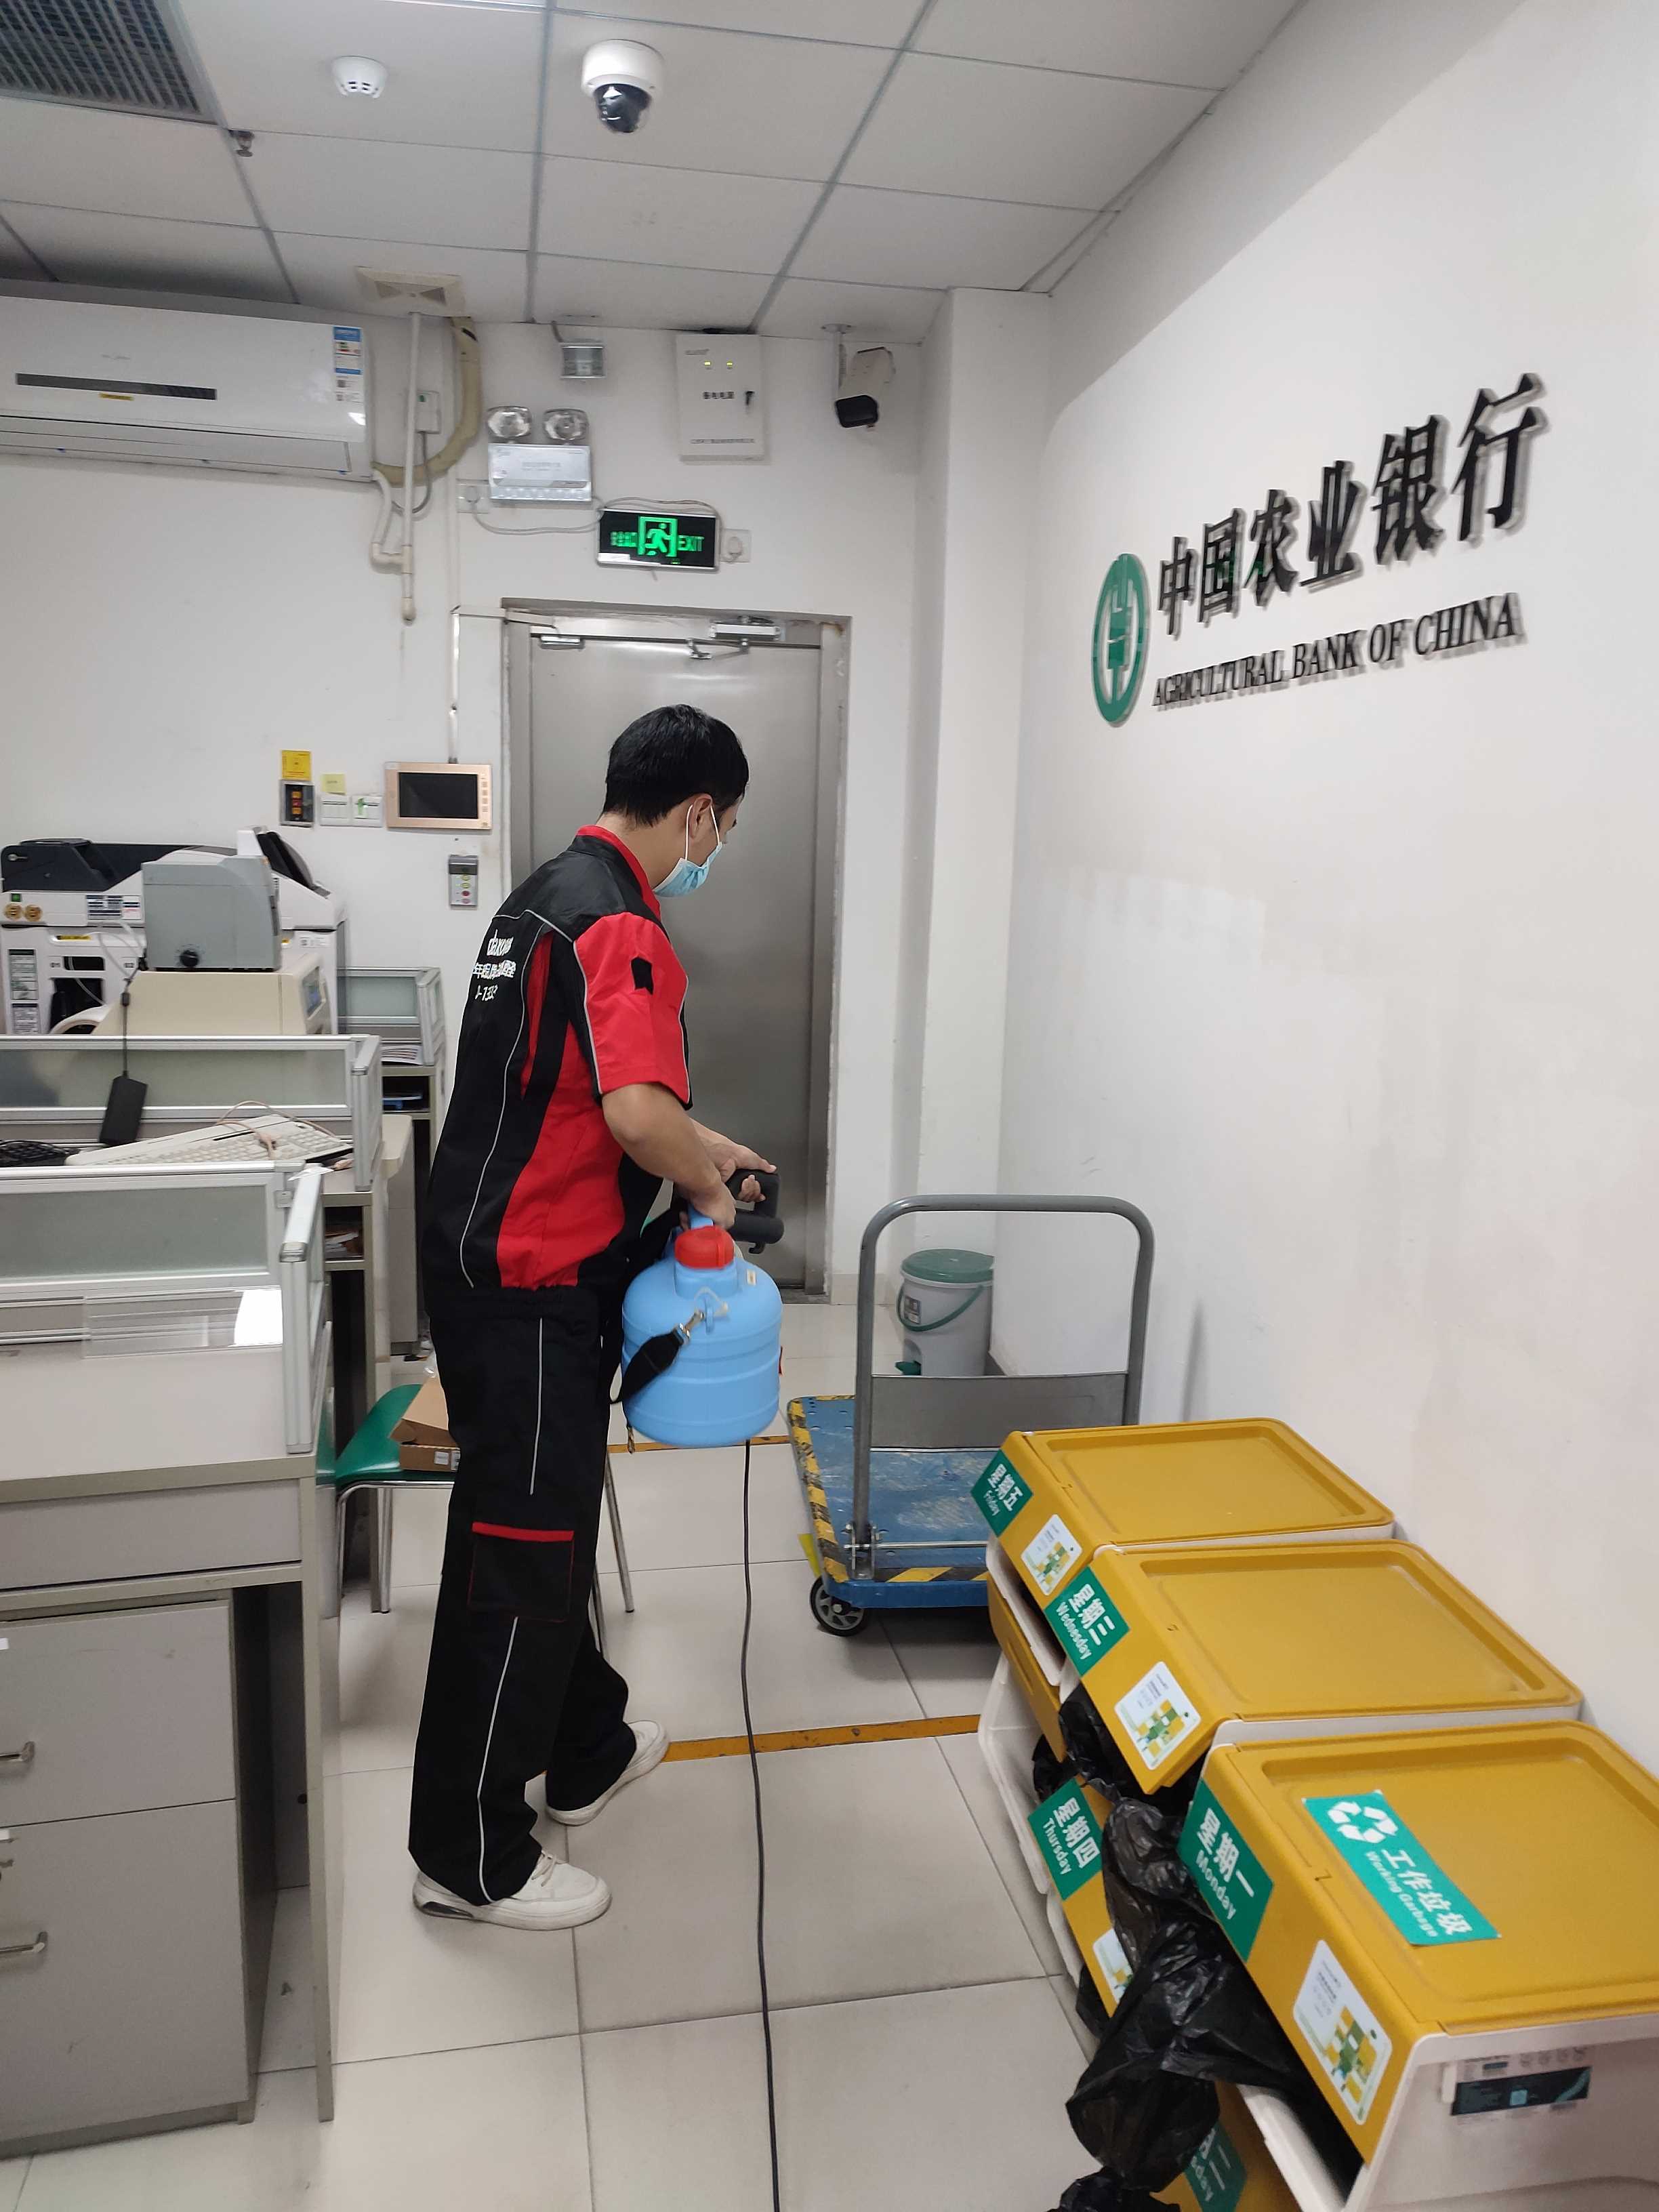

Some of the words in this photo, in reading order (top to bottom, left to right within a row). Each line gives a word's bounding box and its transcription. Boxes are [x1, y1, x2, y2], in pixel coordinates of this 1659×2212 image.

[1158, 373, 1544, 635] 中国农业银行
[678, 534, 704, 552] EXIT
[1152, 649, 1285, 707] AGRICULTURAL
[1292, 630, 1367, 678] BANK
[1369, 619, 1412, 663] OF
[1415, 592, 1522, 655] CHINA
[987, 1463, 1023, 1511] 星期五
[1056, 1601, 1092, 1660] Wednesday
[1068, 1583, 1115, 1645] 星期三
[1042, 1817, 1072, 1875] Thursday
[1052, 1797, 1101, 1869] 星期四
[1196, 1807, 1255, 1898] 星期一
[1195, 1849, 1237, 1920] Monday
[1366, 1851, 1403, 1894] Working
[1399, 1893, 1439, 1937] Garbage
[1381, 1849, 1473, 1936] 工作垃圾
